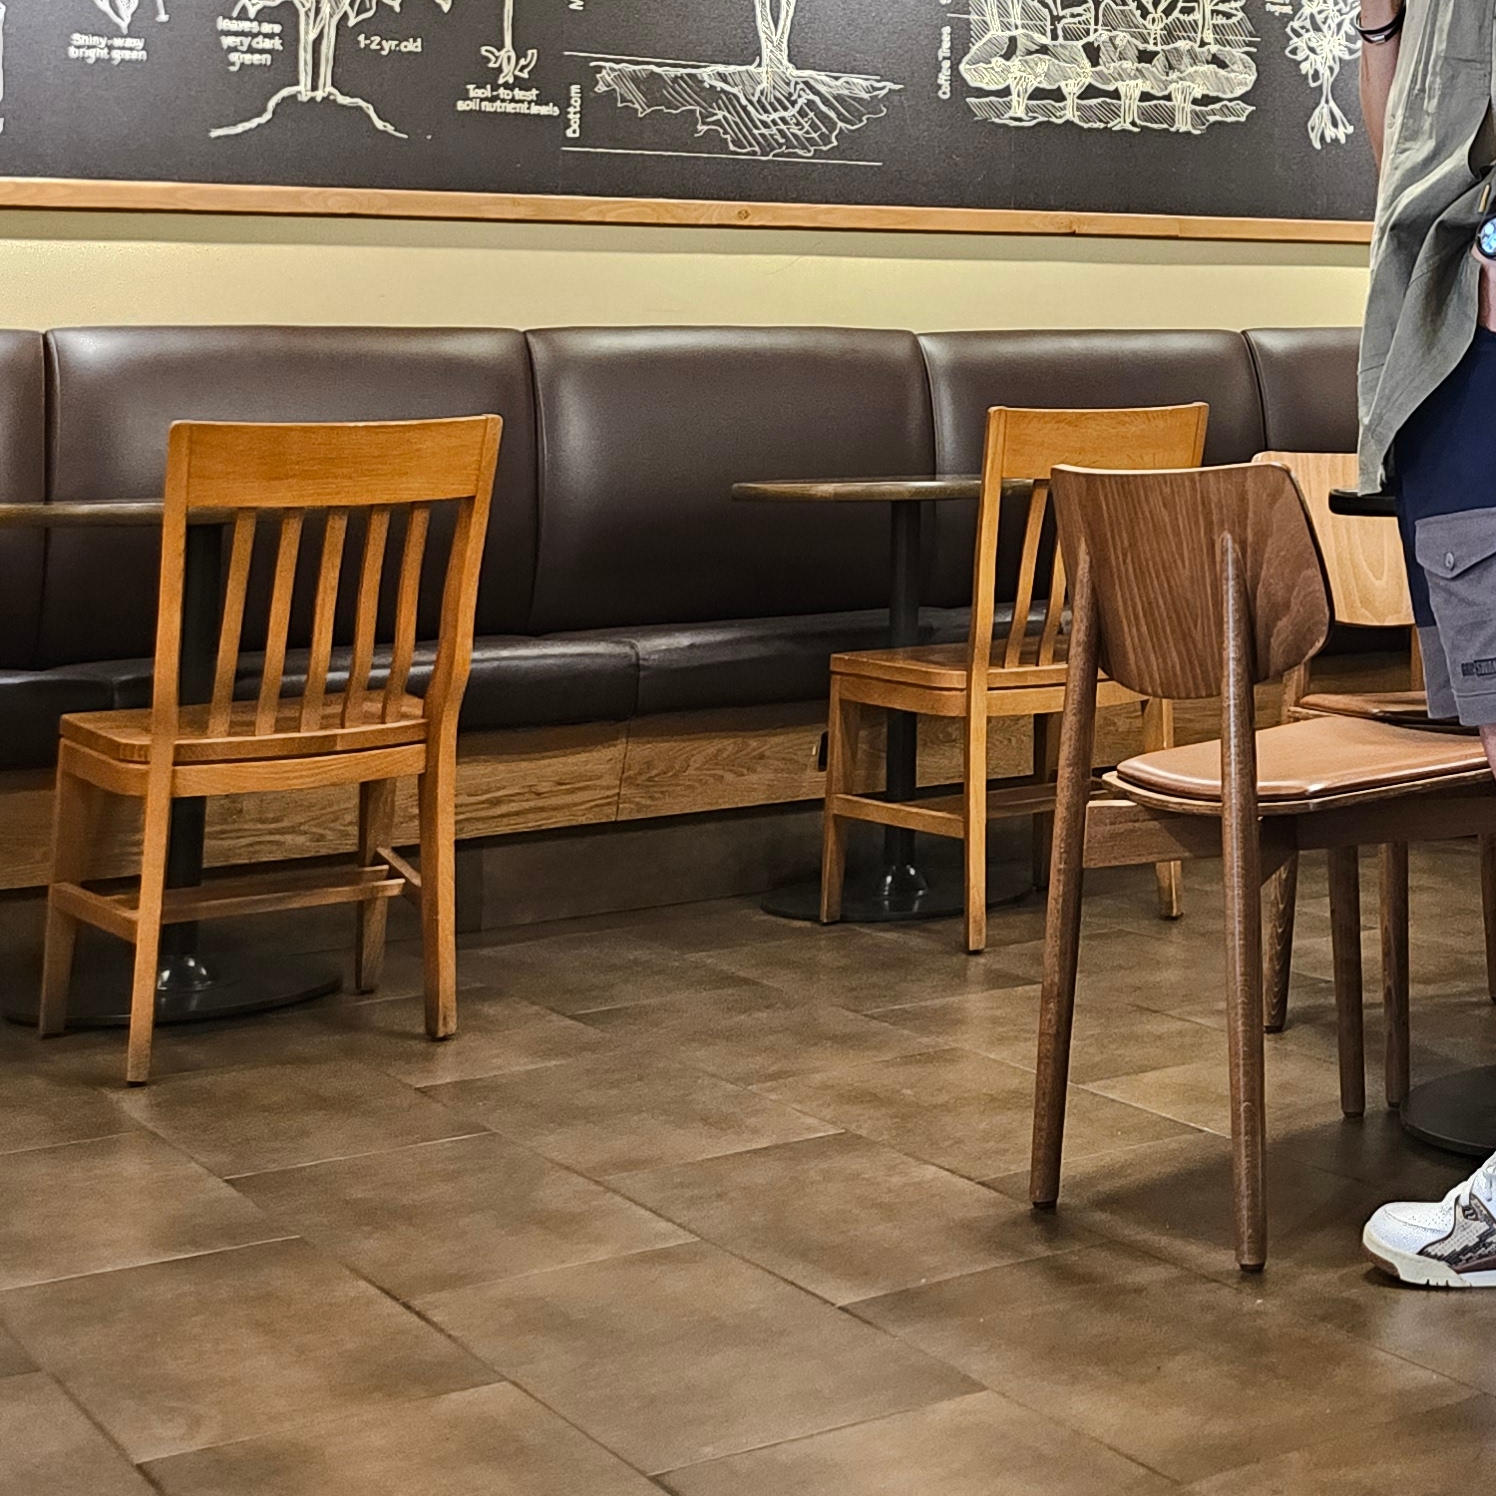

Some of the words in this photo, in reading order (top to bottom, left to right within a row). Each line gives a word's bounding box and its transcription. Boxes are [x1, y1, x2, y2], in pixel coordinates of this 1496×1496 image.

[216, 15, 259, 33] leaves
[260, 20, 283, 34] are
[219, 35, 251, 51] very
[251, 36, 284, 51] dark
[937, 25, 952, 61] Trees
[67, 45, 110, 64] bright
[110, 49, 148, 66] green
[227, 52, 272, 72] green
[937, 60, 952, 100] Coffee
[456, 98, 480, 111] soil
[480, 100, 530, 114] nutrient
[565, 84, 582, 138] Bottom
